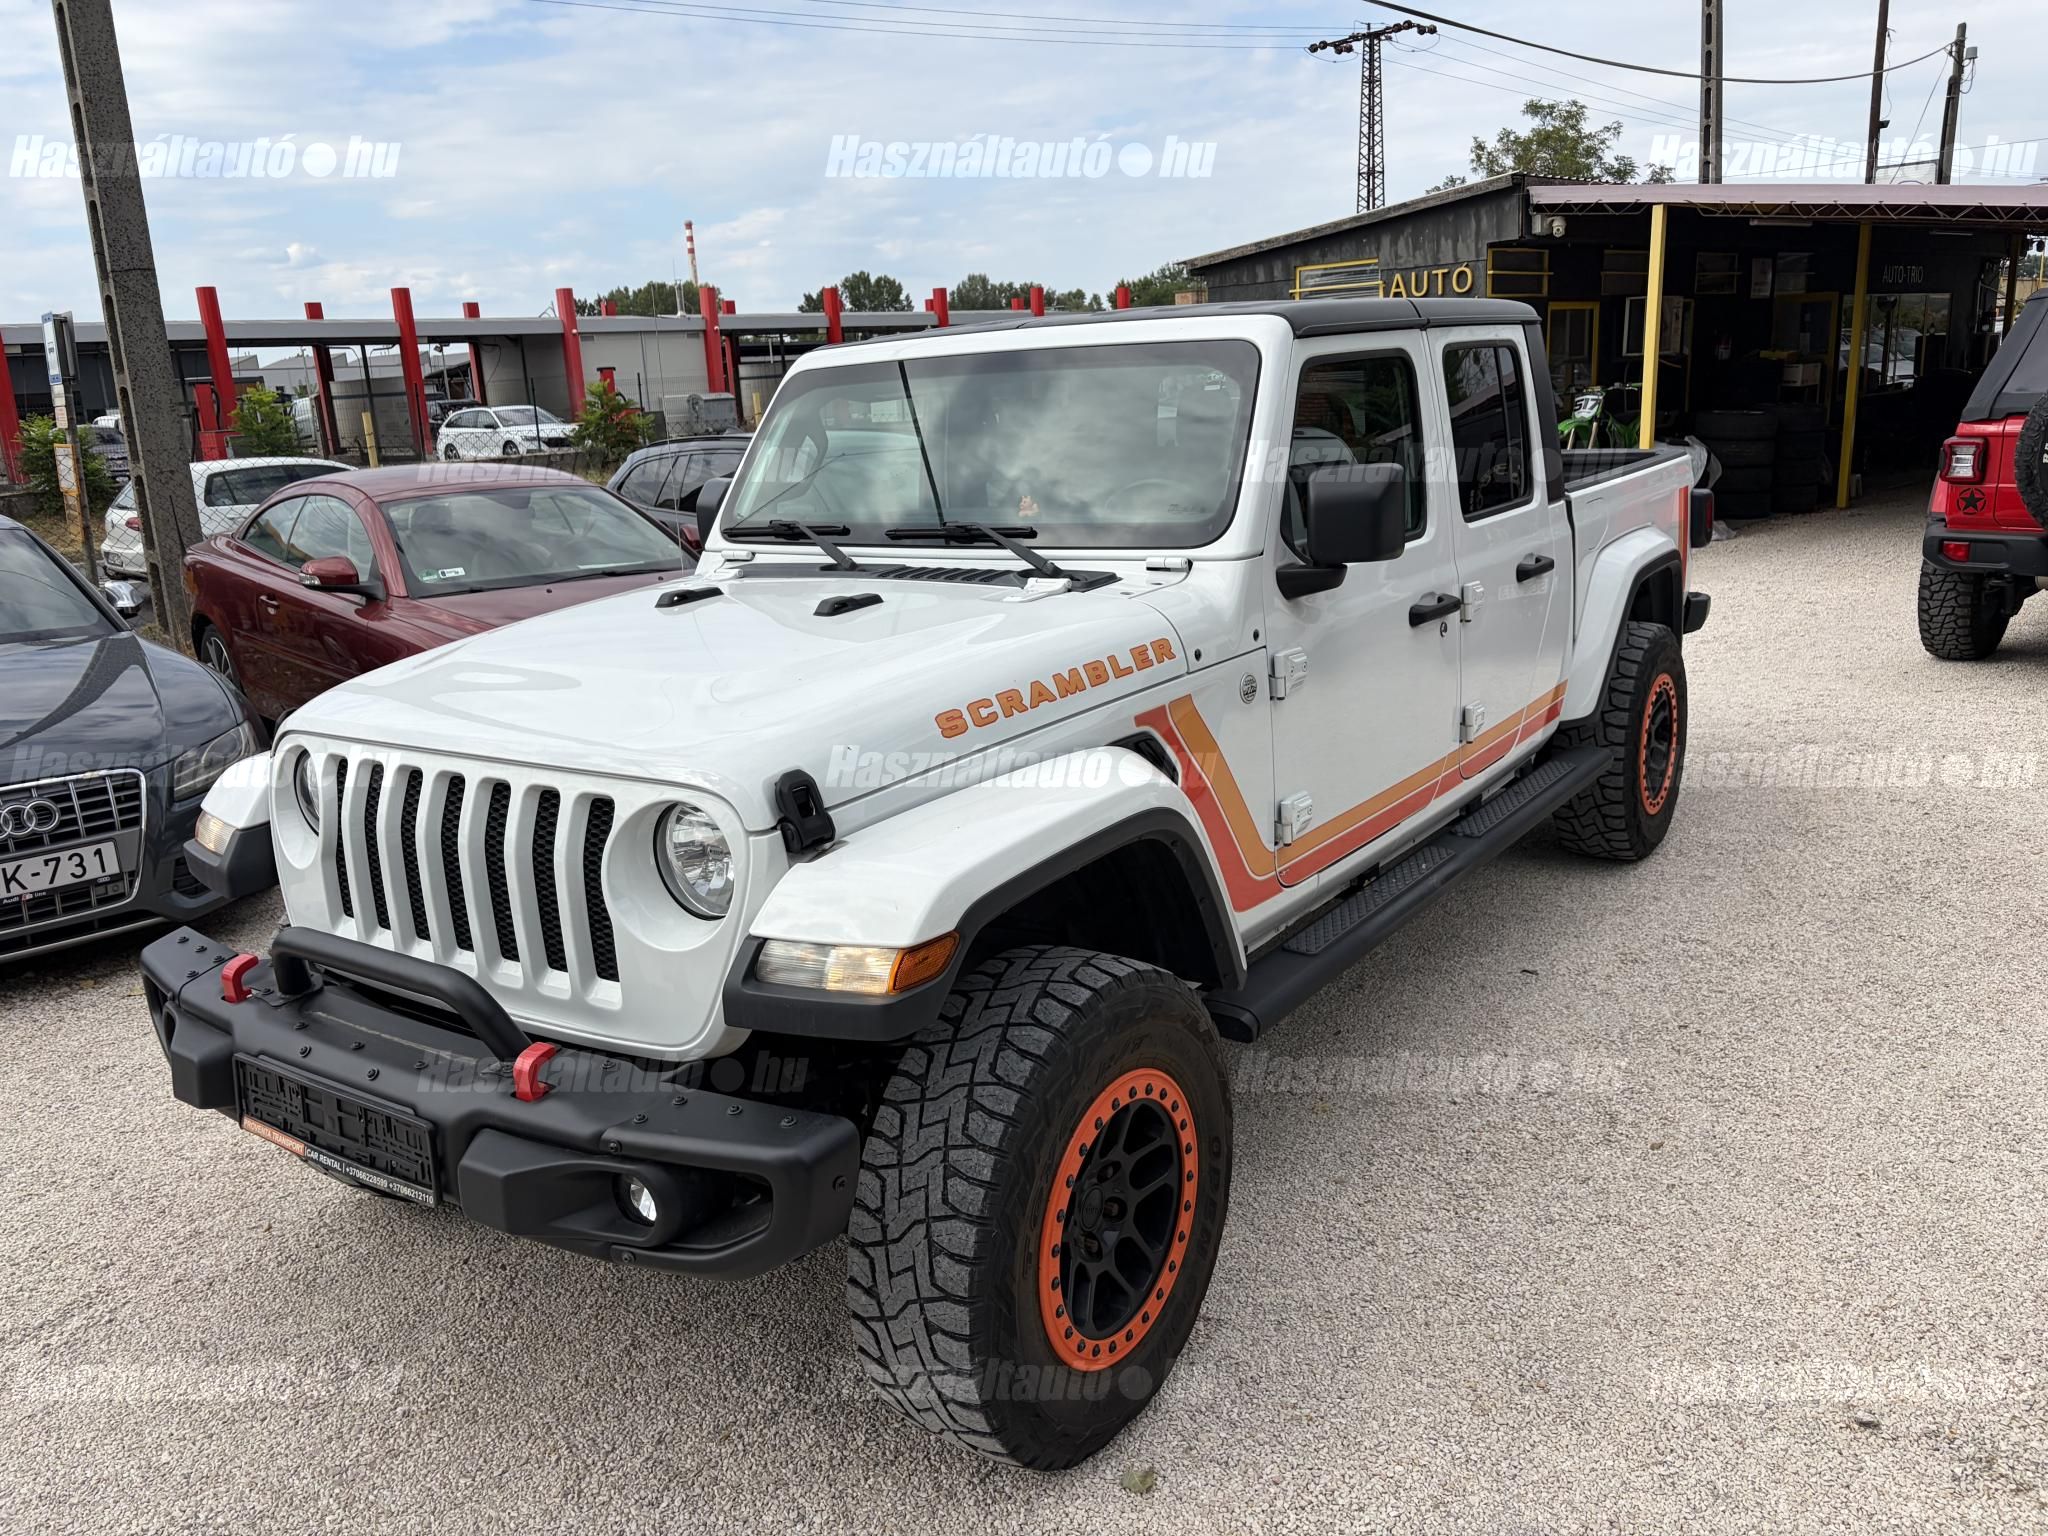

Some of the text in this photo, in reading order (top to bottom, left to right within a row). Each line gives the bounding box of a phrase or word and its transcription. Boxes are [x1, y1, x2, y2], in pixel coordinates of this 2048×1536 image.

[1389, 262, 1473, 299] AUTÓ
[1882, 264, 1924, 284] AUTO-TRIO
[1573, 397, 1602, 412] 517
[935, 638, 1176, 739] SCRAMBLER
[1, 847, 107, 894] K-731
[306, 1148, 319, 1161] CAR
[320, 1154, 342, 1171] RENTAL
